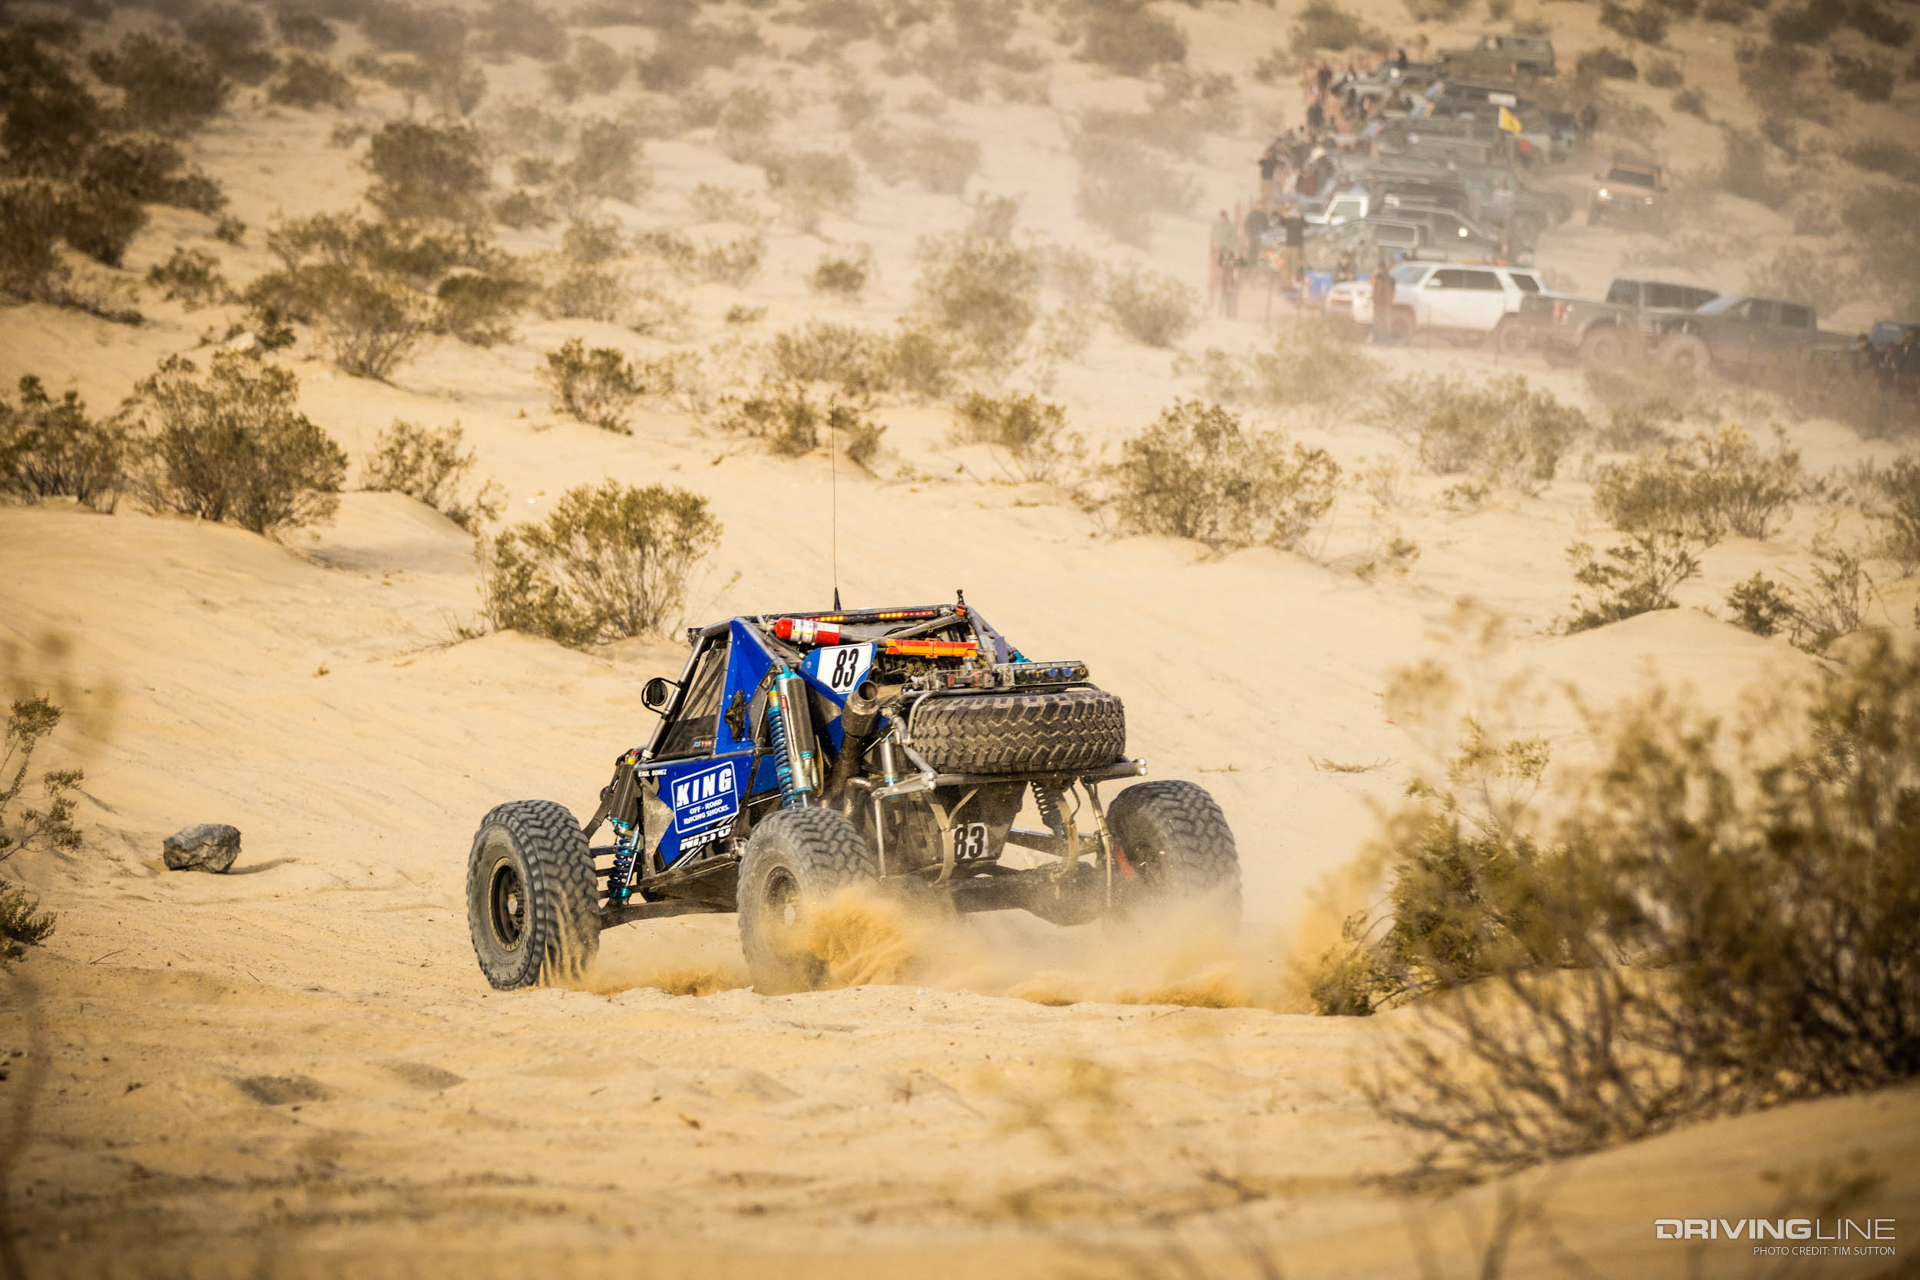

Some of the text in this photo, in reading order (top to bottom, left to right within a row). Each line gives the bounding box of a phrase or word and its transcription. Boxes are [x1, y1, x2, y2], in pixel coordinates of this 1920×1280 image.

[832, 648, 859, 688] 83
[676, 768, 732, 807] KING
[683, 812, 706, 825] RACING
[954, 826, 984, 859] 83
